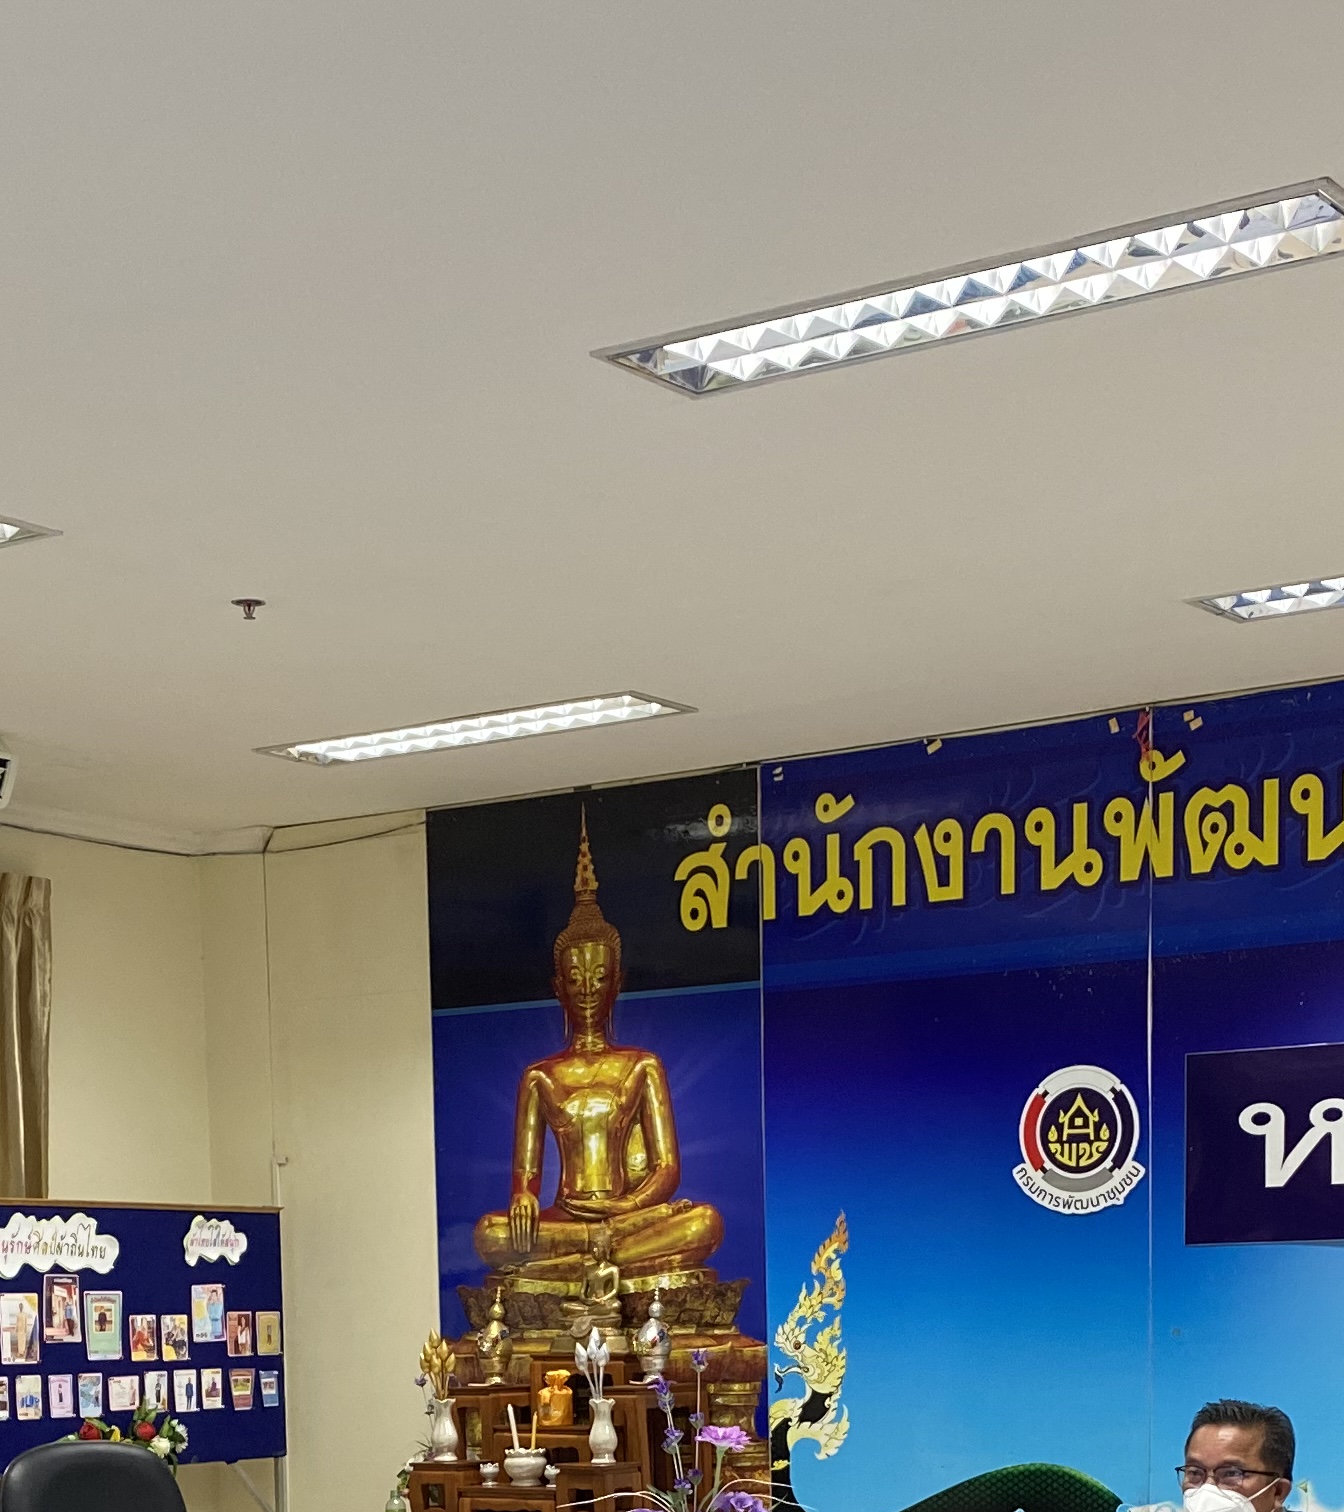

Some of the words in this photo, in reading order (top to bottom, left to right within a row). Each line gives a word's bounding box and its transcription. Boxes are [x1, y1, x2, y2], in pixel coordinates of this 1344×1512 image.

[1015, 1164, 1141, 1211] กรมการพัฒนาชุมชน
